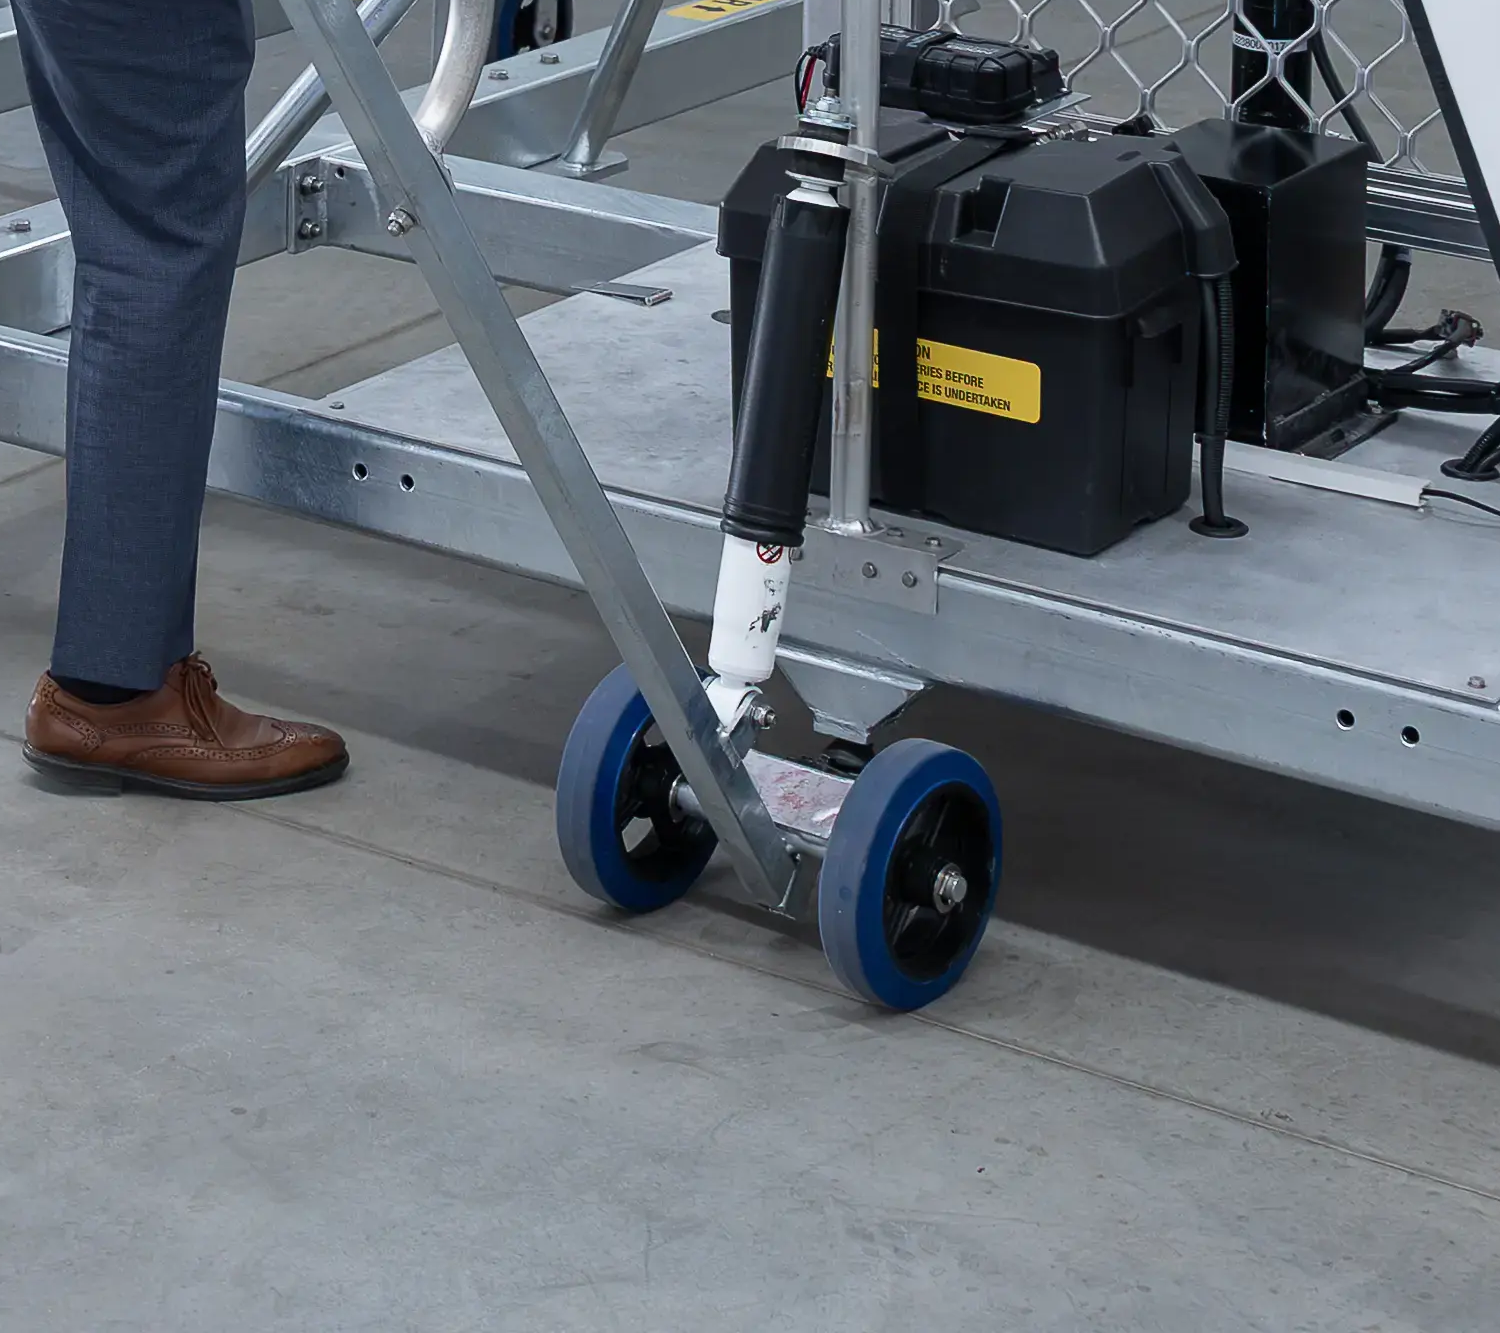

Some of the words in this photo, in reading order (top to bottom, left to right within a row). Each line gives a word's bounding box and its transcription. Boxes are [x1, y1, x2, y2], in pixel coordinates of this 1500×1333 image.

[945, 369, 984, 389] BEFORE
[932, 383, 943, 396] IS
[944, 386, 1012, 412] UNDERTAKEN
